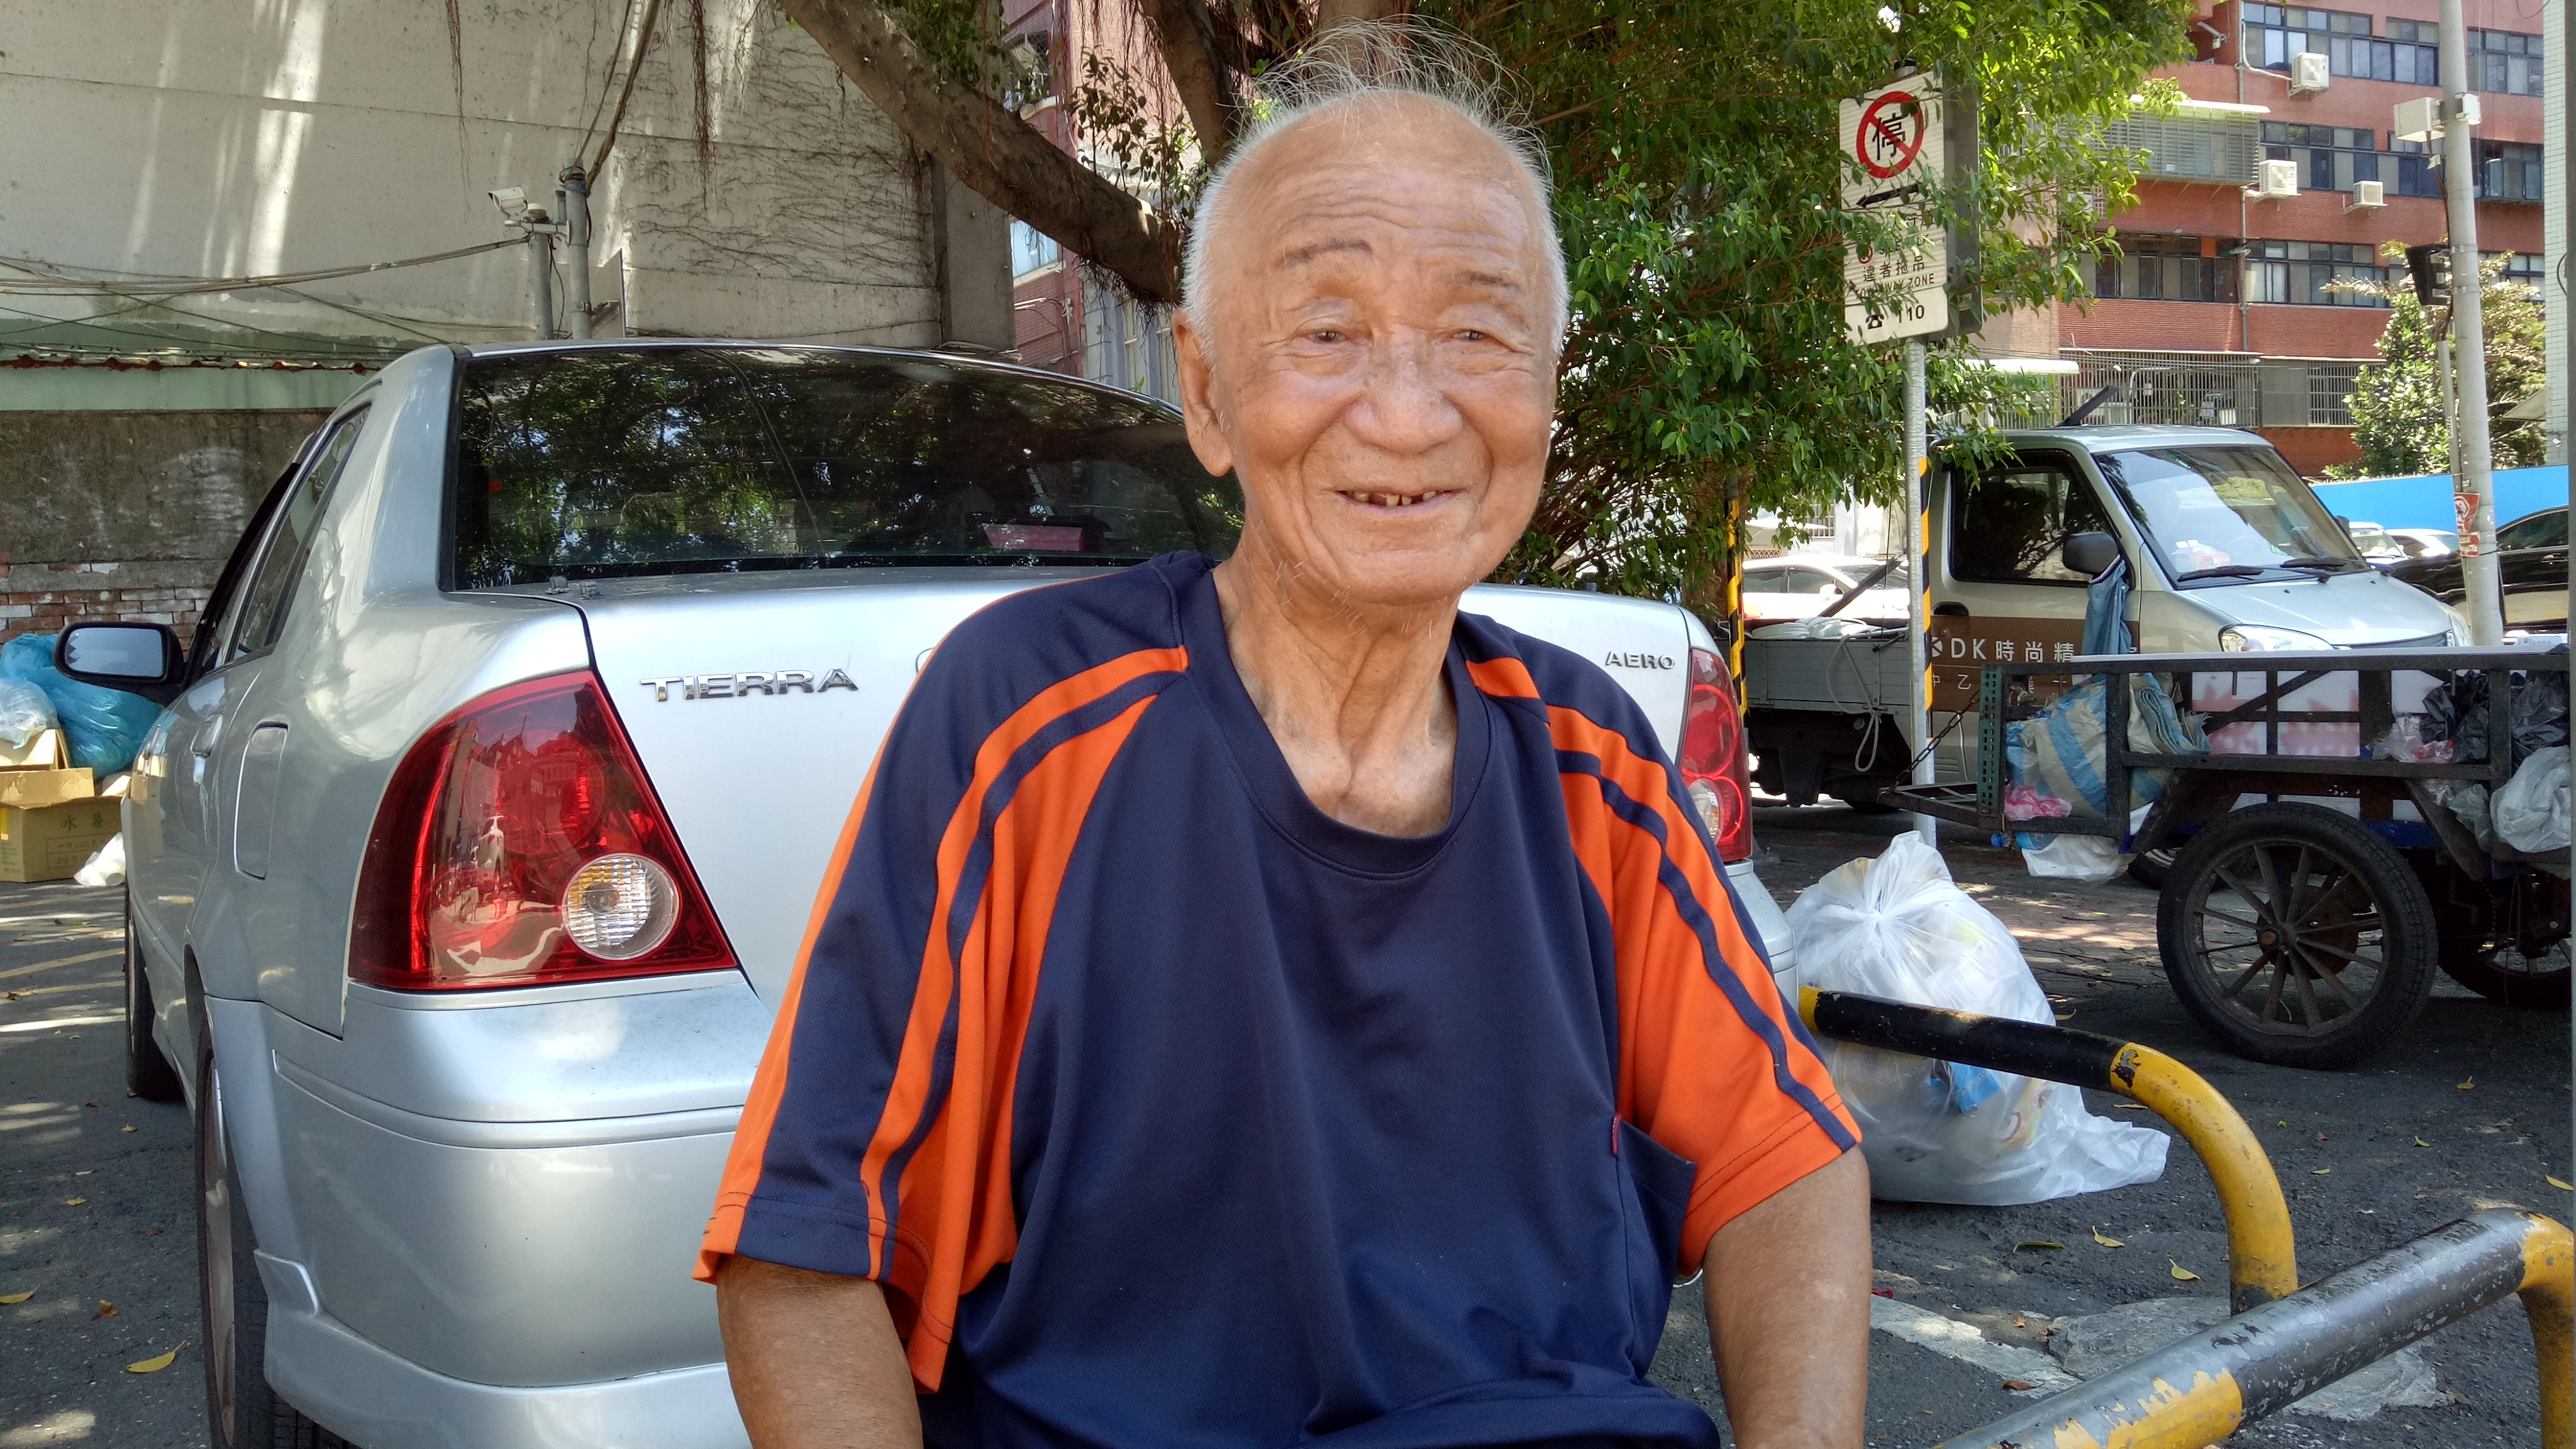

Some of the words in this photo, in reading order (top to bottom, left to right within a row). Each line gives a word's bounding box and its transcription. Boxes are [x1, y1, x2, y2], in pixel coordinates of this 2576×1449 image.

[1872, 113, 1906, 160] 停
[1863, 255, 1924, 282] 違者拖吊
[1908, 273, 1935, 288] ZONE
[1898, 304, 1924, 323] 110
[1605, 650, 1675, 669] AERO
[640, 668, 859, 702] TIERRA
